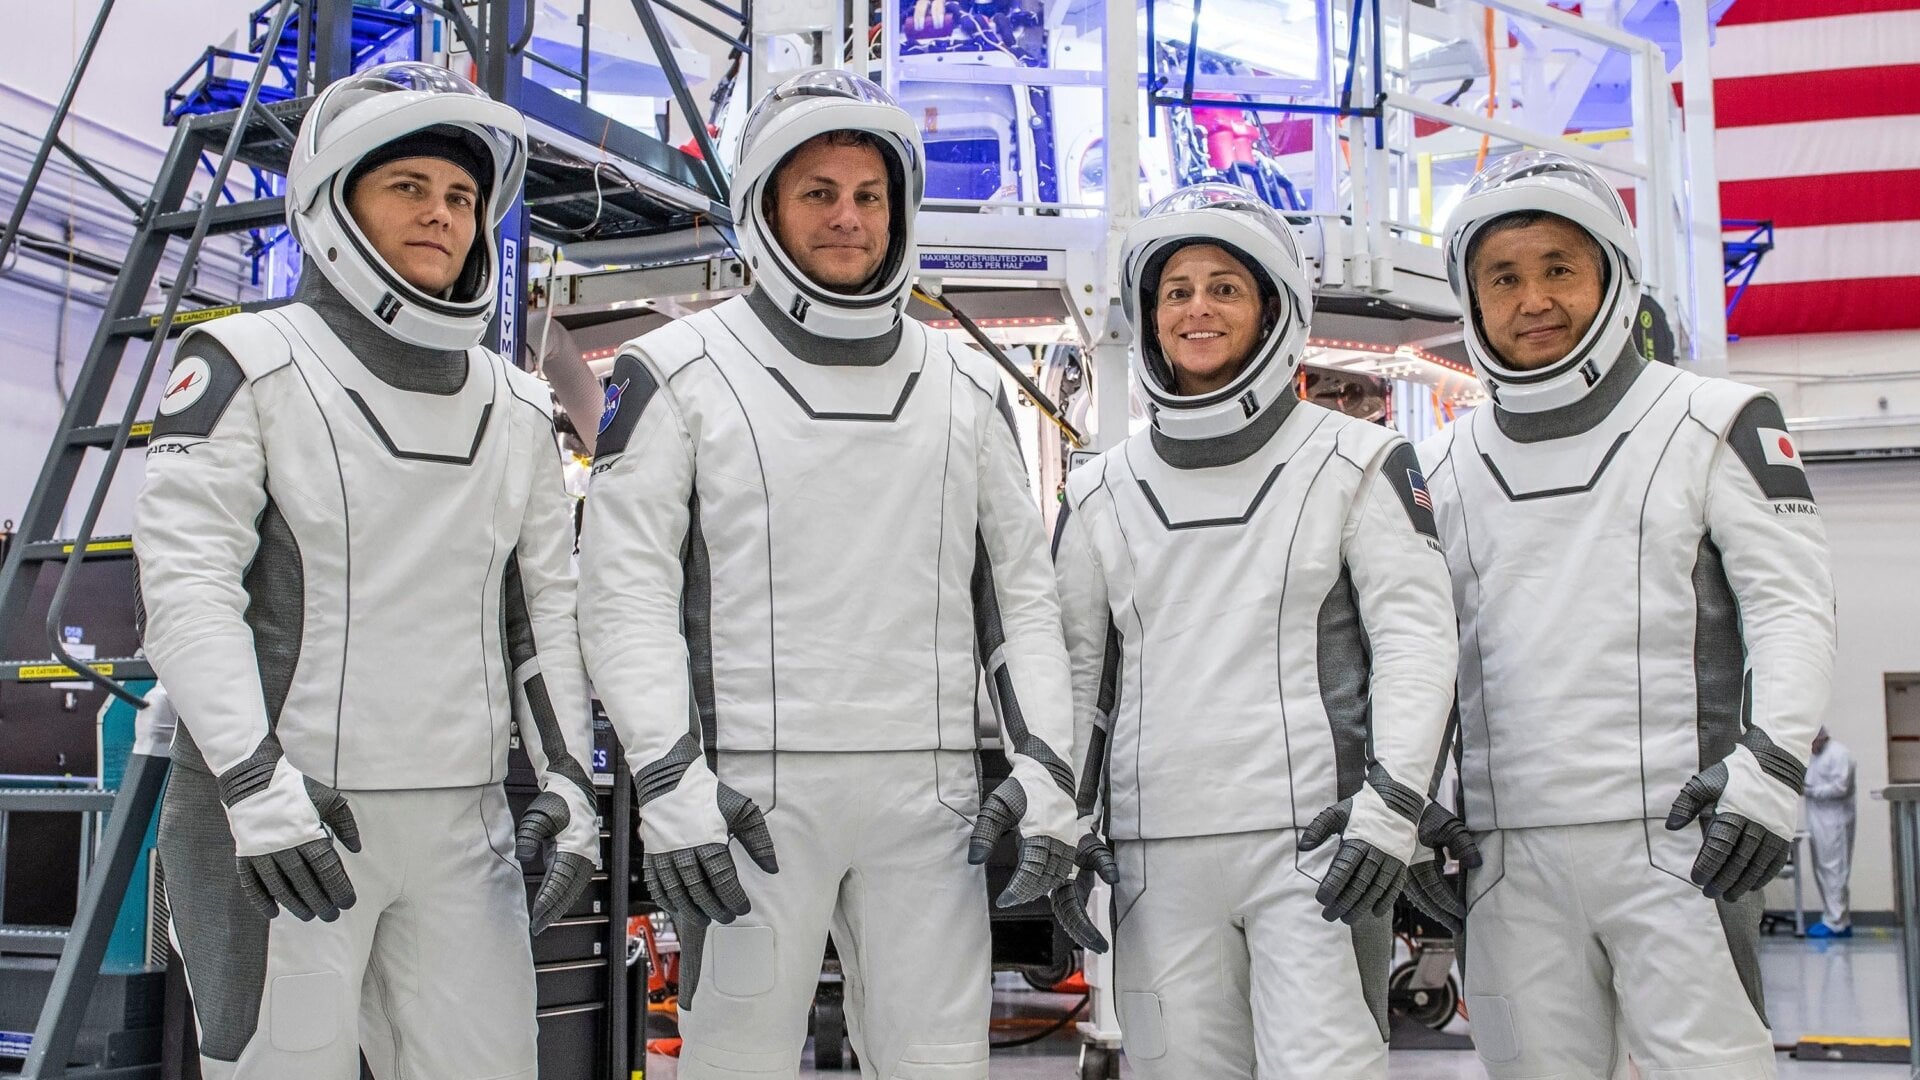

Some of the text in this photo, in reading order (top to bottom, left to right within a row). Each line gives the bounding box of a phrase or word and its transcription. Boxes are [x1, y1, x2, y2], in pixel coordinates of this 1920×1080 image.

[963, 255, 1019, 263] DISTRIBUTED
[1020, 255, 1041, 263] LOAD
[1003, 262, 1024, 270] HALF
[183, 312, 213, 322] CAPACITY
